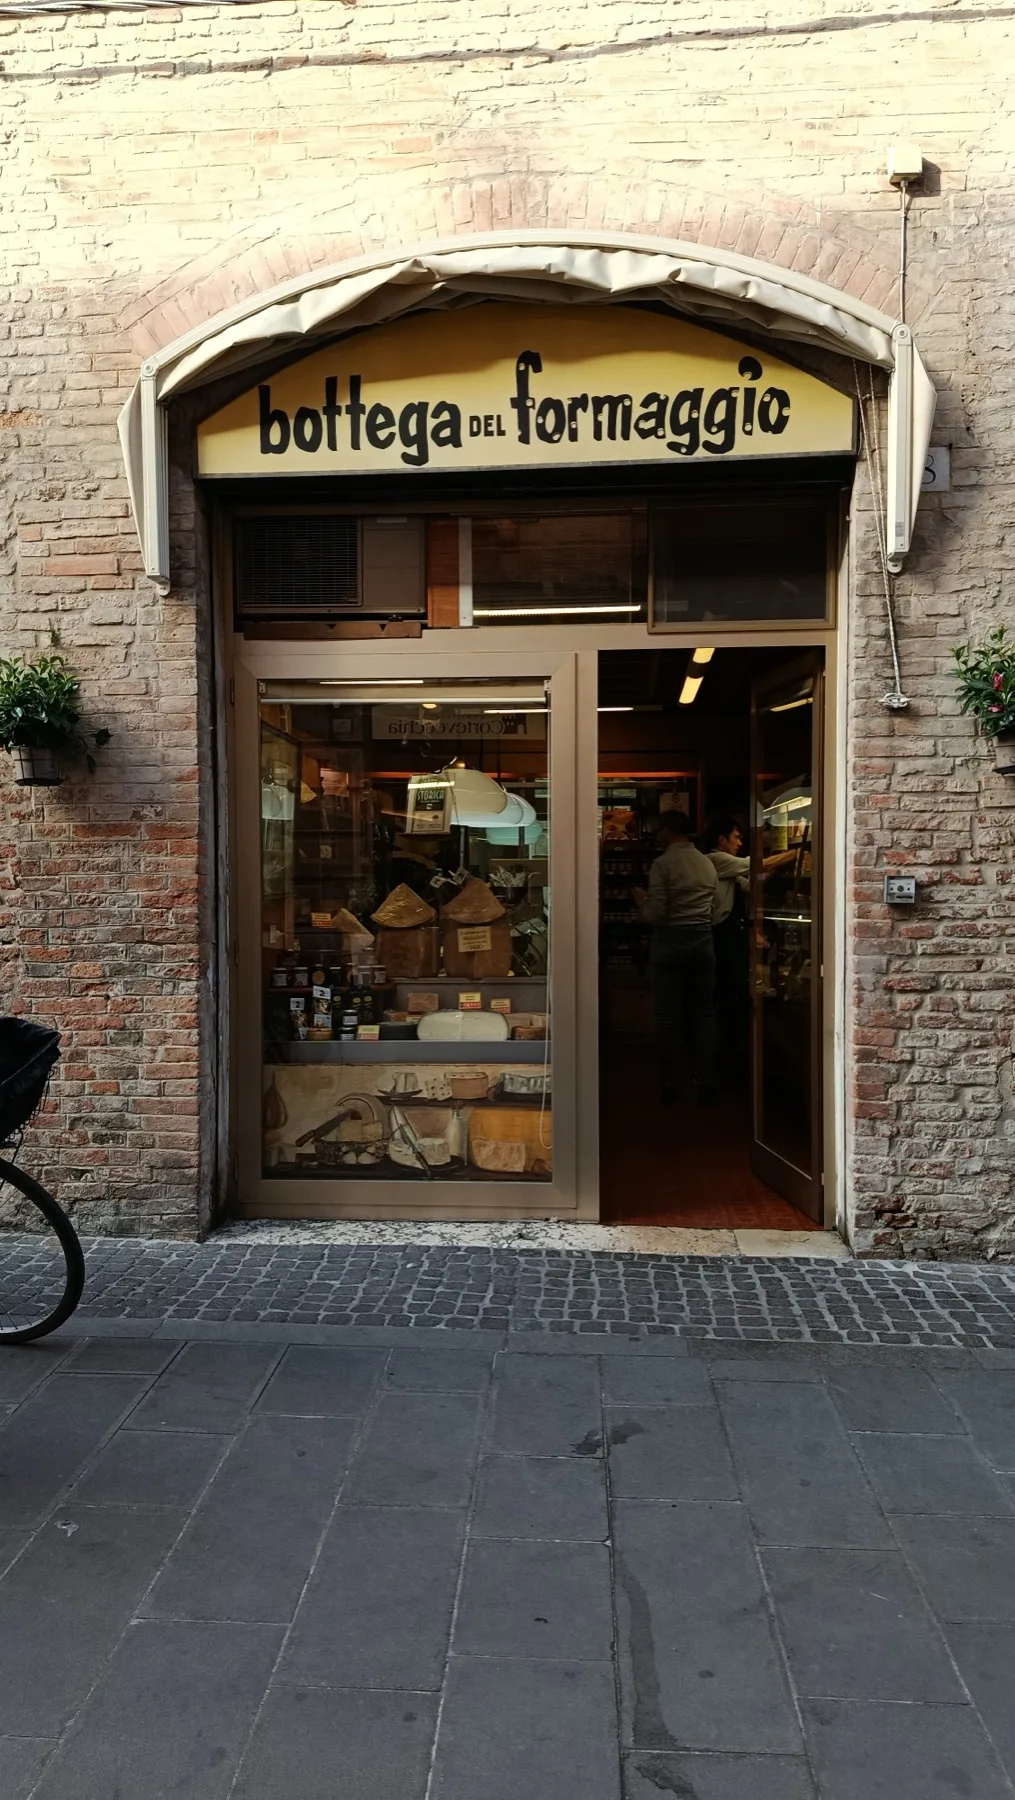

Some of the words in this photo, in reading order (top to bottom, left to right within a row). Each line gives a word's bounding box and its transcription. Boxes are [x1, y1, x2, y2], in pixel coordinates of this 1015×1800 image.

[259, 375, 463, 466] bottega
[469, 414, 506, 438] DEL
[510, 350, 790, 455] formaggio
[417, 790, 445, 801] STORICA
